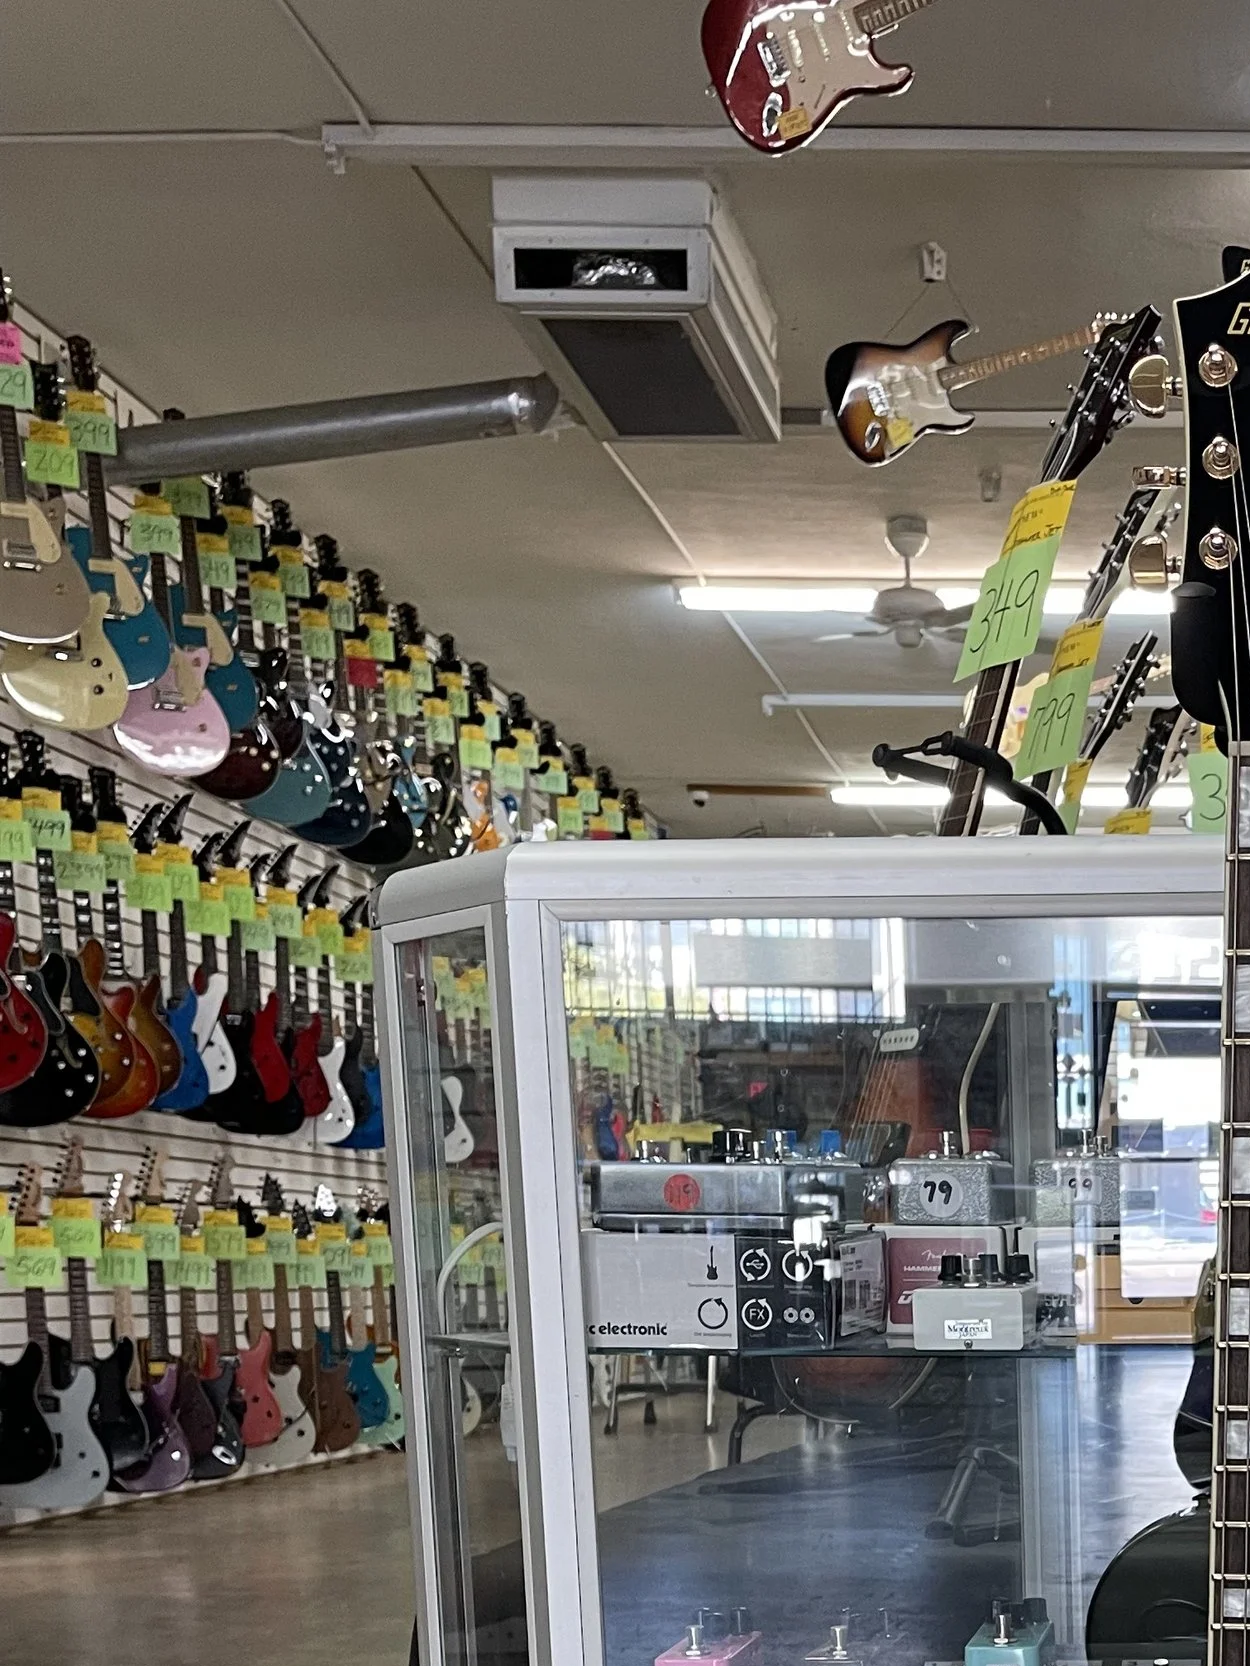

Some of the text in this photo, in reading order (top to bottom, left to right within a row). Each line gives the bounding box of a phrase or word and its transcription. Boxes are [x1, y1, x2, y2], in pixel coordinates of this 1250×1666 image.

[1, 370, 27, 395] 29
[970, 569, 1040, 654] 349
[1028, 692, 1076, 760] 799
[1199, 773, 1226, 821] 3
[922, 1179, 953, 1206] 79
[16, 1255, 57, 1278] 569
[749, 1308, 765, 1321] FX
[598, 1321, 668, 1336] electronic
